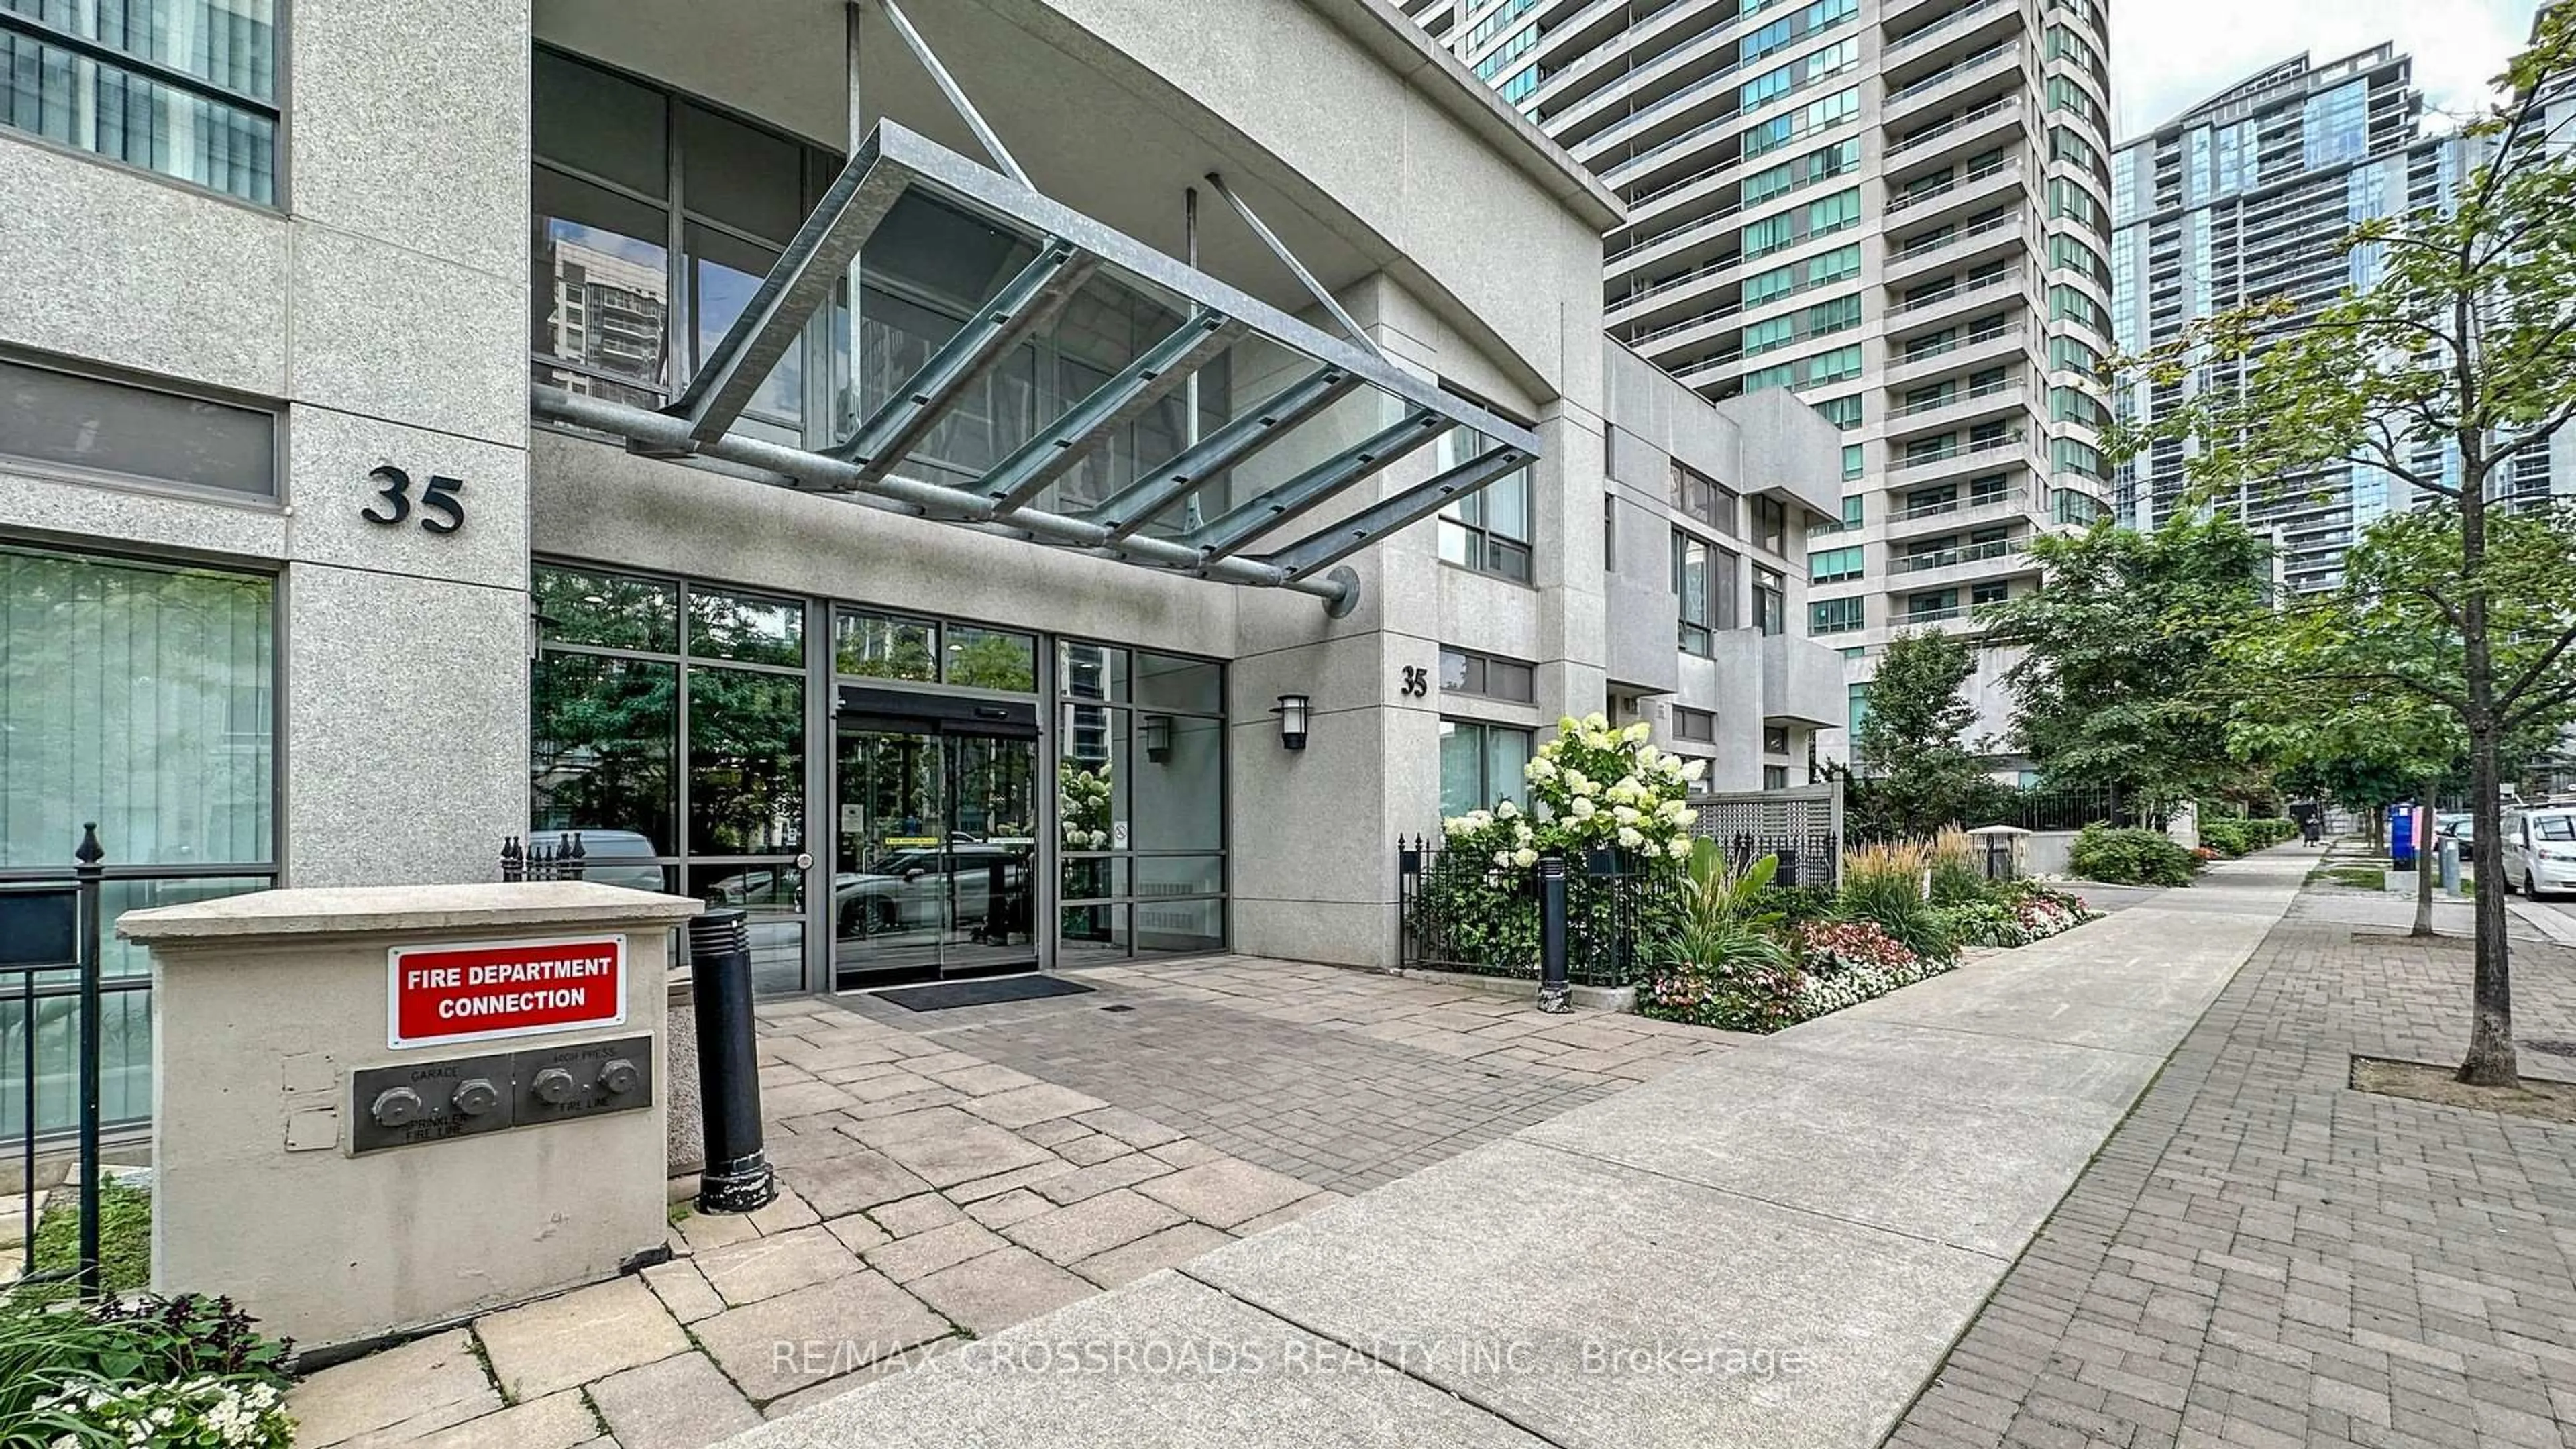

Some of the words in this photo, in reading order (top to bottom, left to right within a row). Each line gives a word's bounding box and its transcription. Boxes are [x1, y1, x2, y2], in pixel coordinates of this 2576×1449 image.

[361, 466, 464, 533] 35
[1401, 665, 1428, 698] 35
[407, 968, 461, 989] FIRE
[468, 957, 612, 985] DEPARTMENT
[438, 987, 585, 1018] CONNECTION
[405, 1114, 467, 1129] PRINKLER
